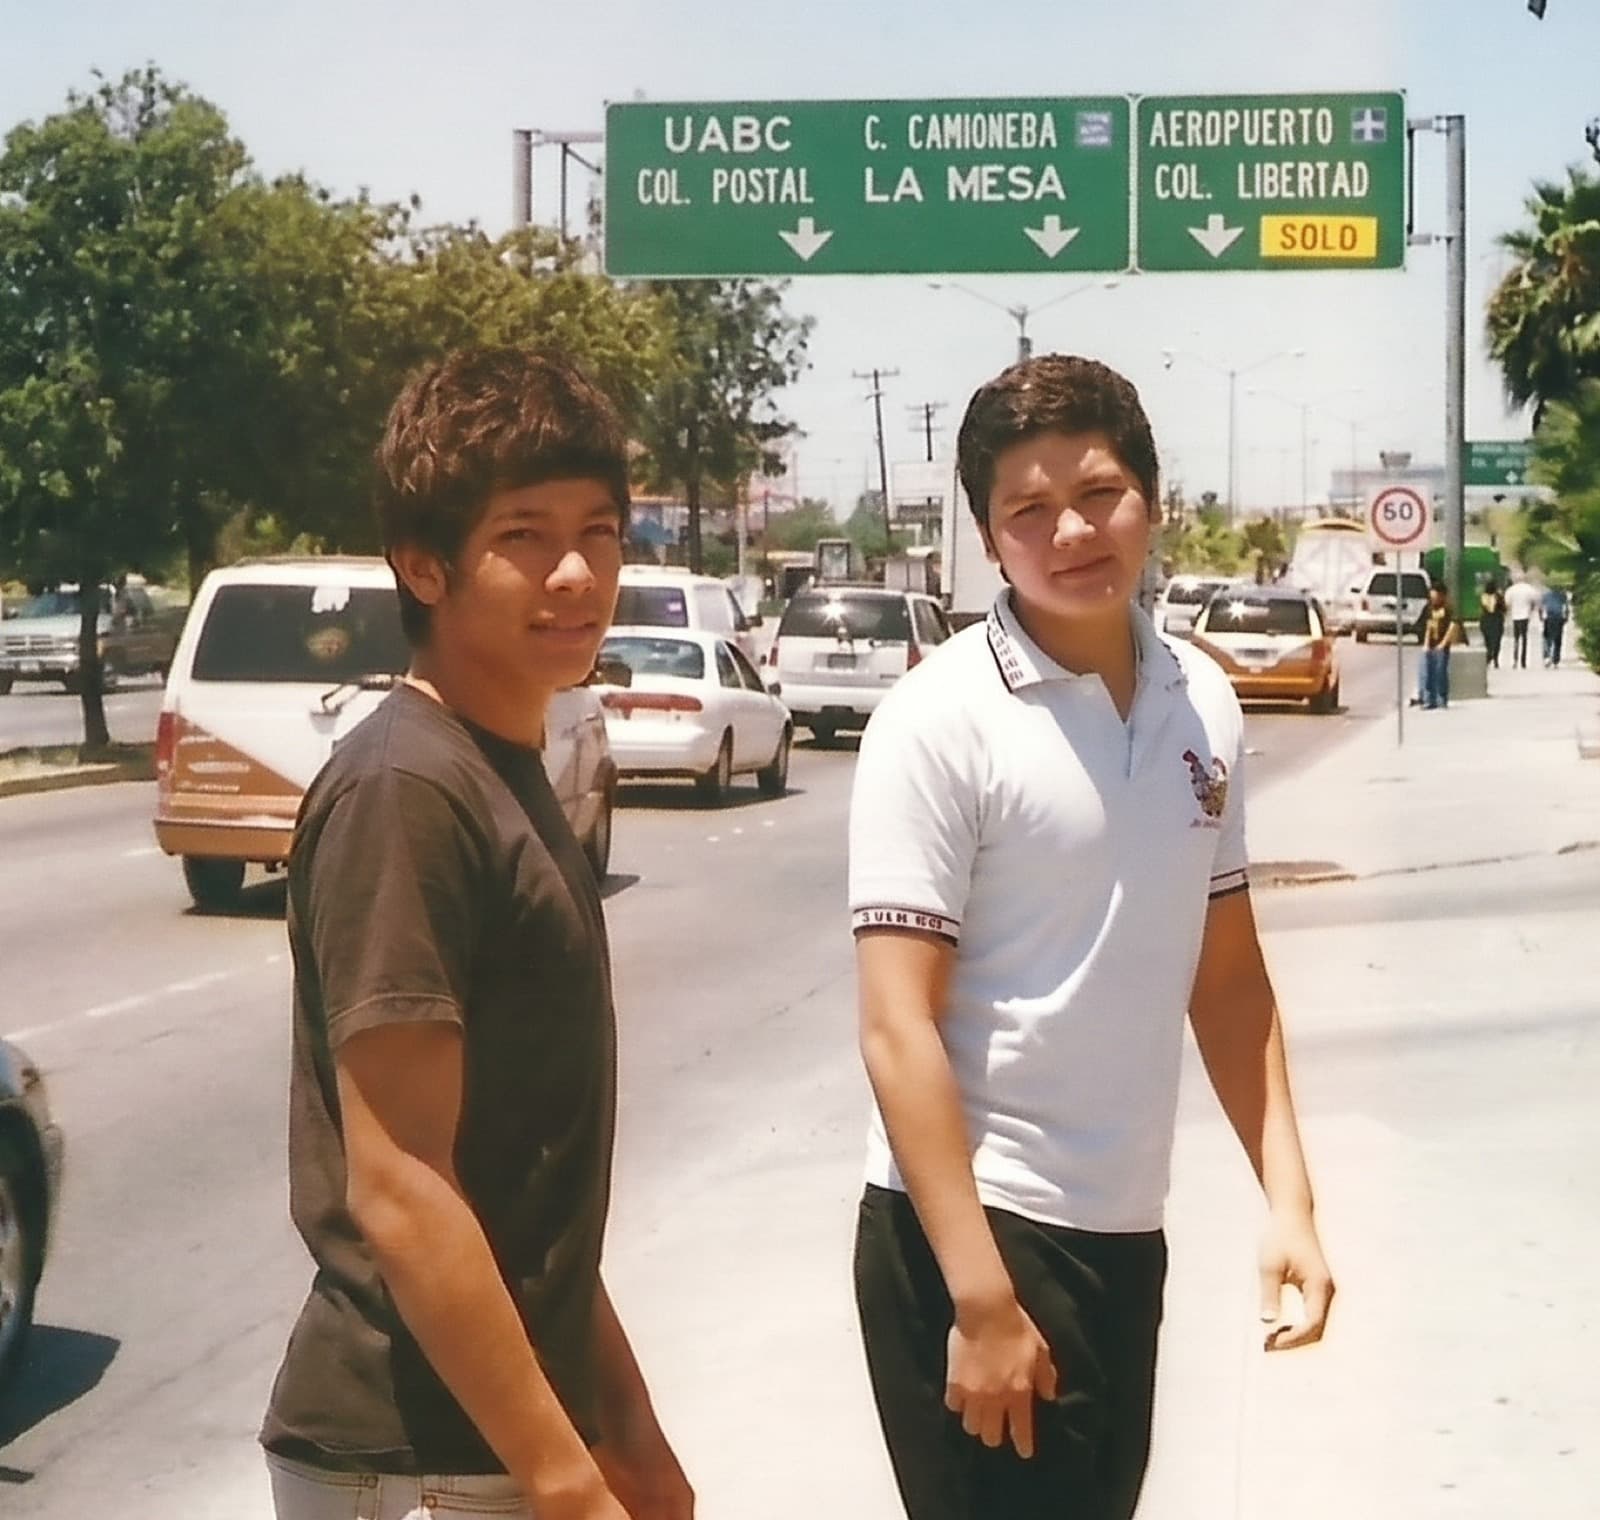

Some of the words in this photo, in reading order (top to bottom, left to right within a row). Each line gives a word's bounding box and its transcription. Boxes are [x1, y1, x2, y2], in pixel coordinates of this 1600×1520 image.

[665, 115, 791, 153] UABC
[865, 115, 887, 150] C.
[637, 168, 691, 205] COL.
[712, 167, 814, 205] POSTAL
[865, 167, 923, 203] LA
[947, 164, 1066, 202] MESA
[1155, 163, 1213, 200] COL.
[1237, 161, 1370, 199] LIBERTAD
[1280, 223, 1358, 251] SOLO
[1383, 502, 1413, 521] 50
